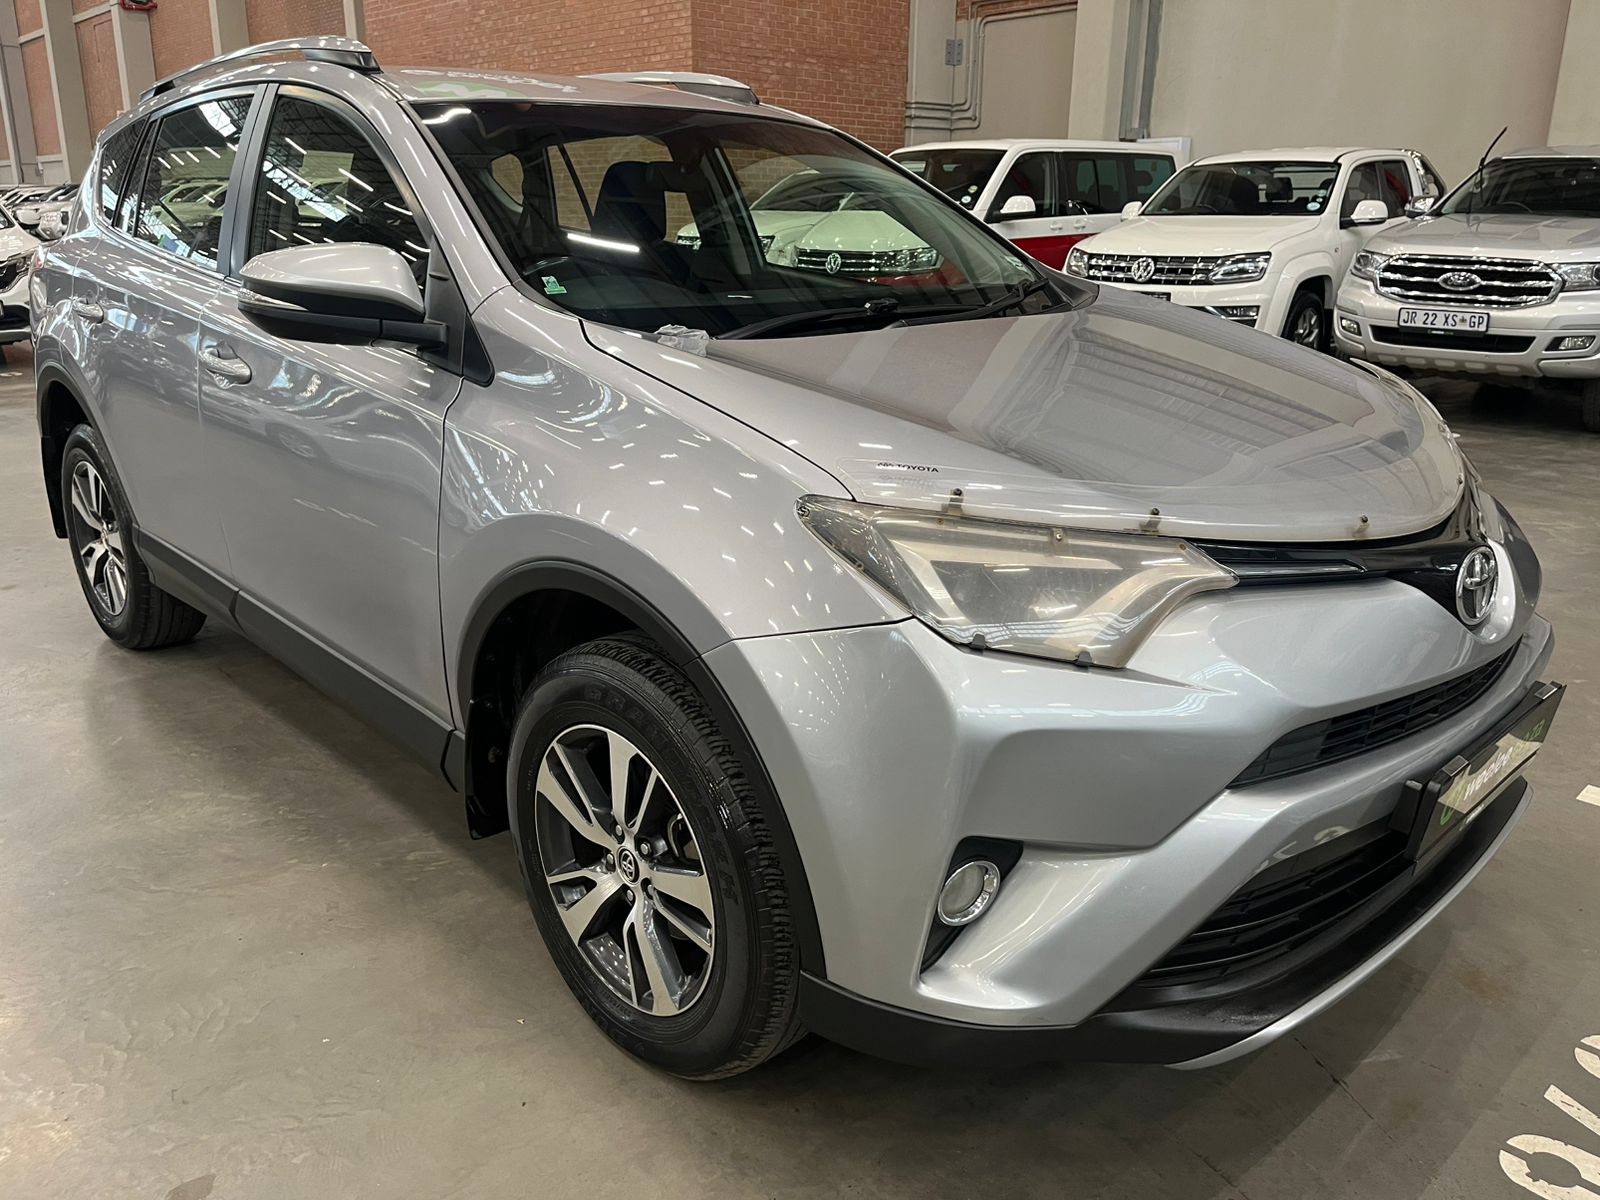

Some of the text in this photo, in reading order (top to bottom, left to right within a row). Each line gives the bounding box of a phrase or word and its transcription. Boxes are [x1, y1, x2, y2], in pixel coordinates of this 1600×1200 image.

[1402, 311, 1484, 328] JR 22 XS GP
[897, 463, 939, 472] TOYOTA
